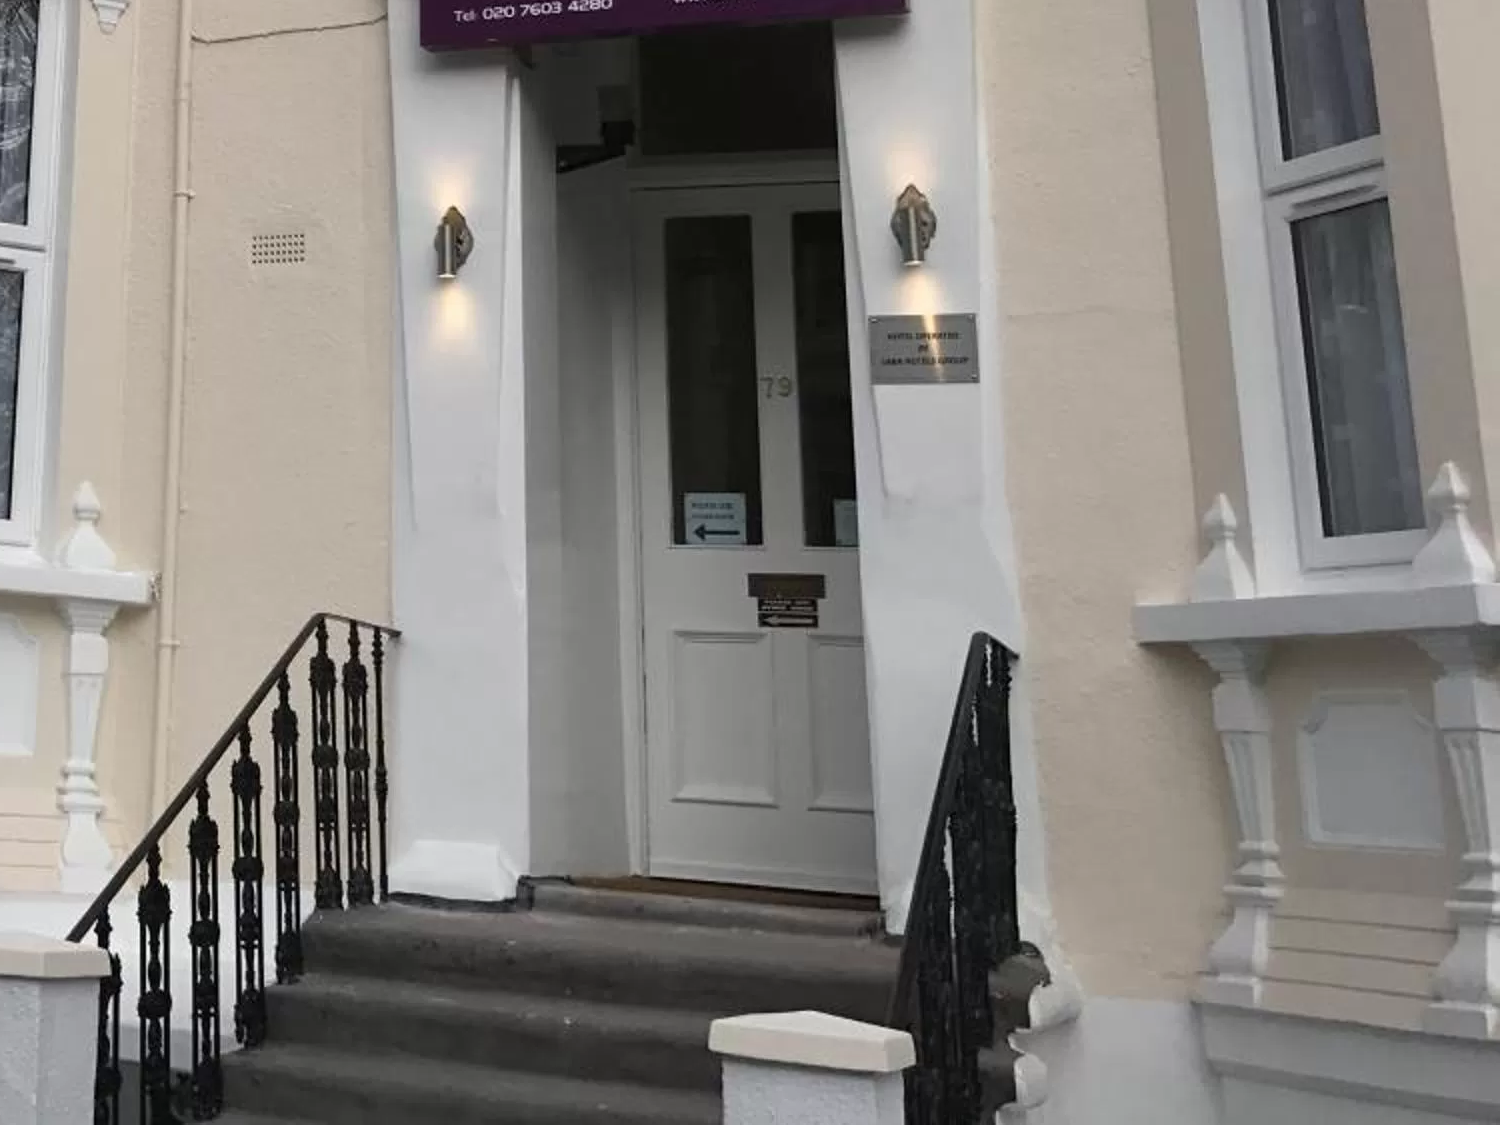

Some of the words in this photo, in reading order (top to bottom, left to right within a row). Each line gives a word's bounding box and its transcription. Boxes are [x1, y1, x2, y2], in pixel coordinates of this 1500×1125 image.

[482, 5, 515, 20] 020
[520, 0, 563, 17] 7603
[760, 377, 792, 398] 79
